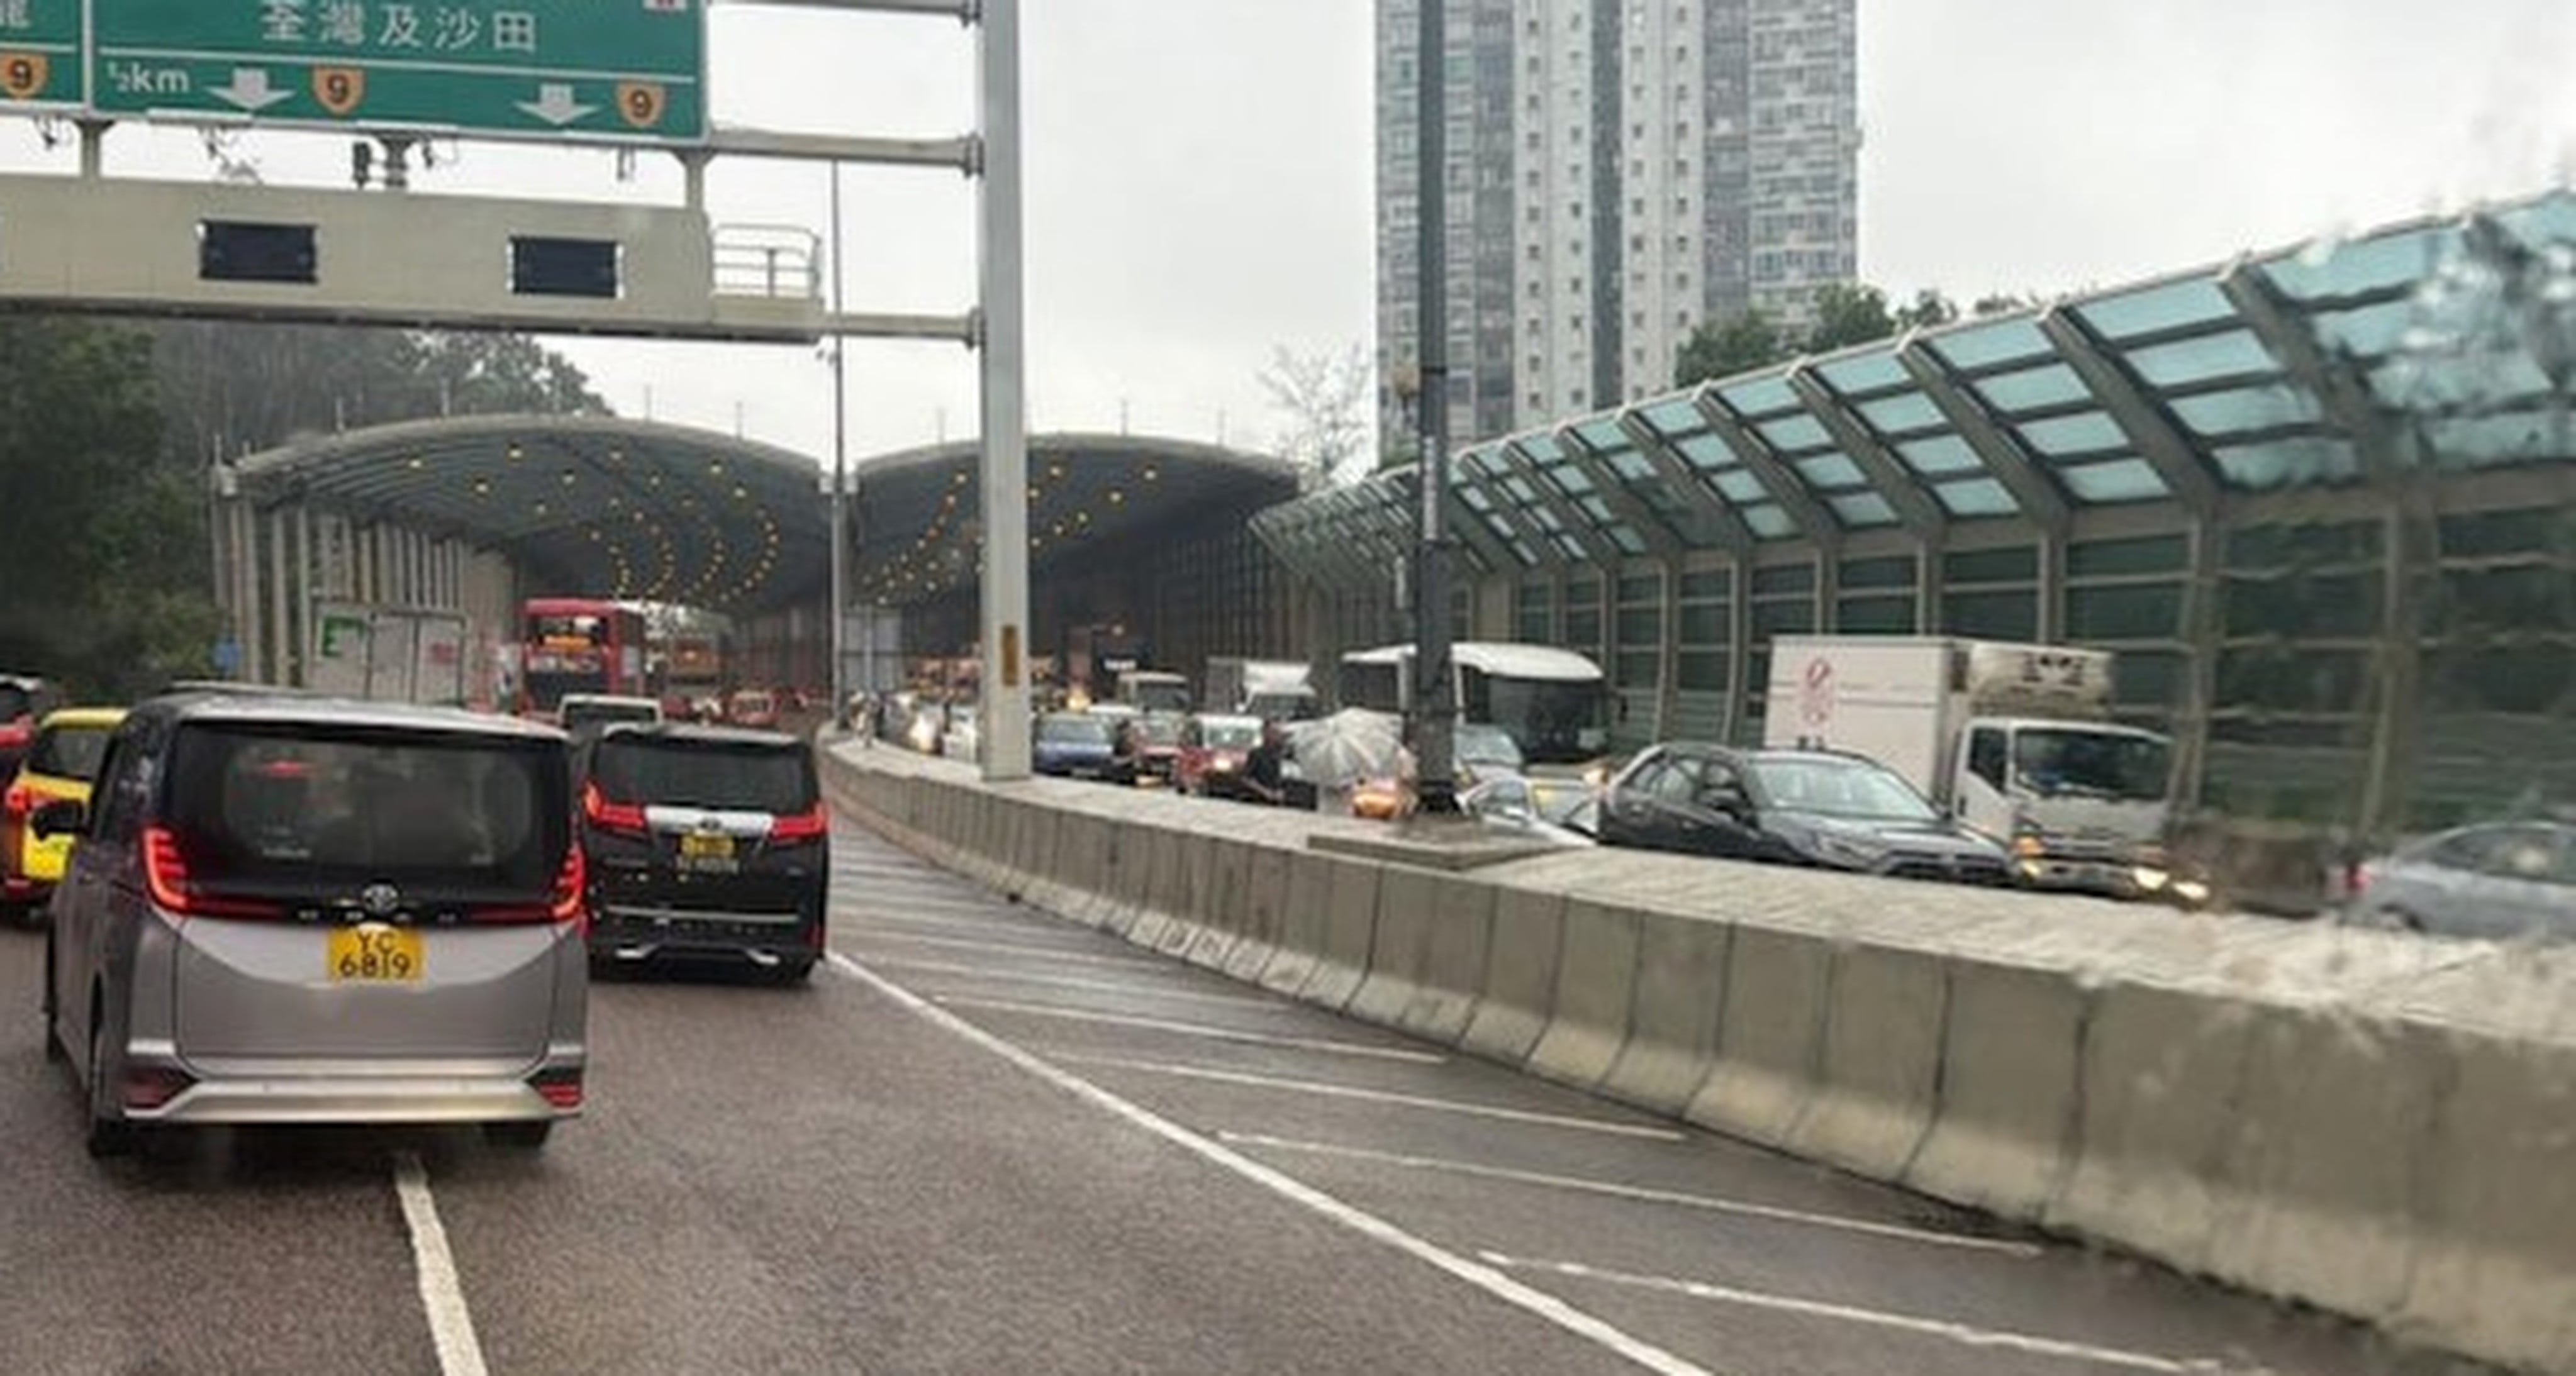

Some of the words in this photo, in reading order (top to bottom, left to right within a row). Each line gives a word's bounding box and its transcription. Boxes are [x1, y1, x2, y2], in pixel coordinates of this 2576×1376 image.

[11, 59, 33, 90] 9
[326, 74, 350, 105] 9
[629, 89, 652, 118] 9
[357, 931, 395, 952] YC
[339, 952, 411, 979] 6819
